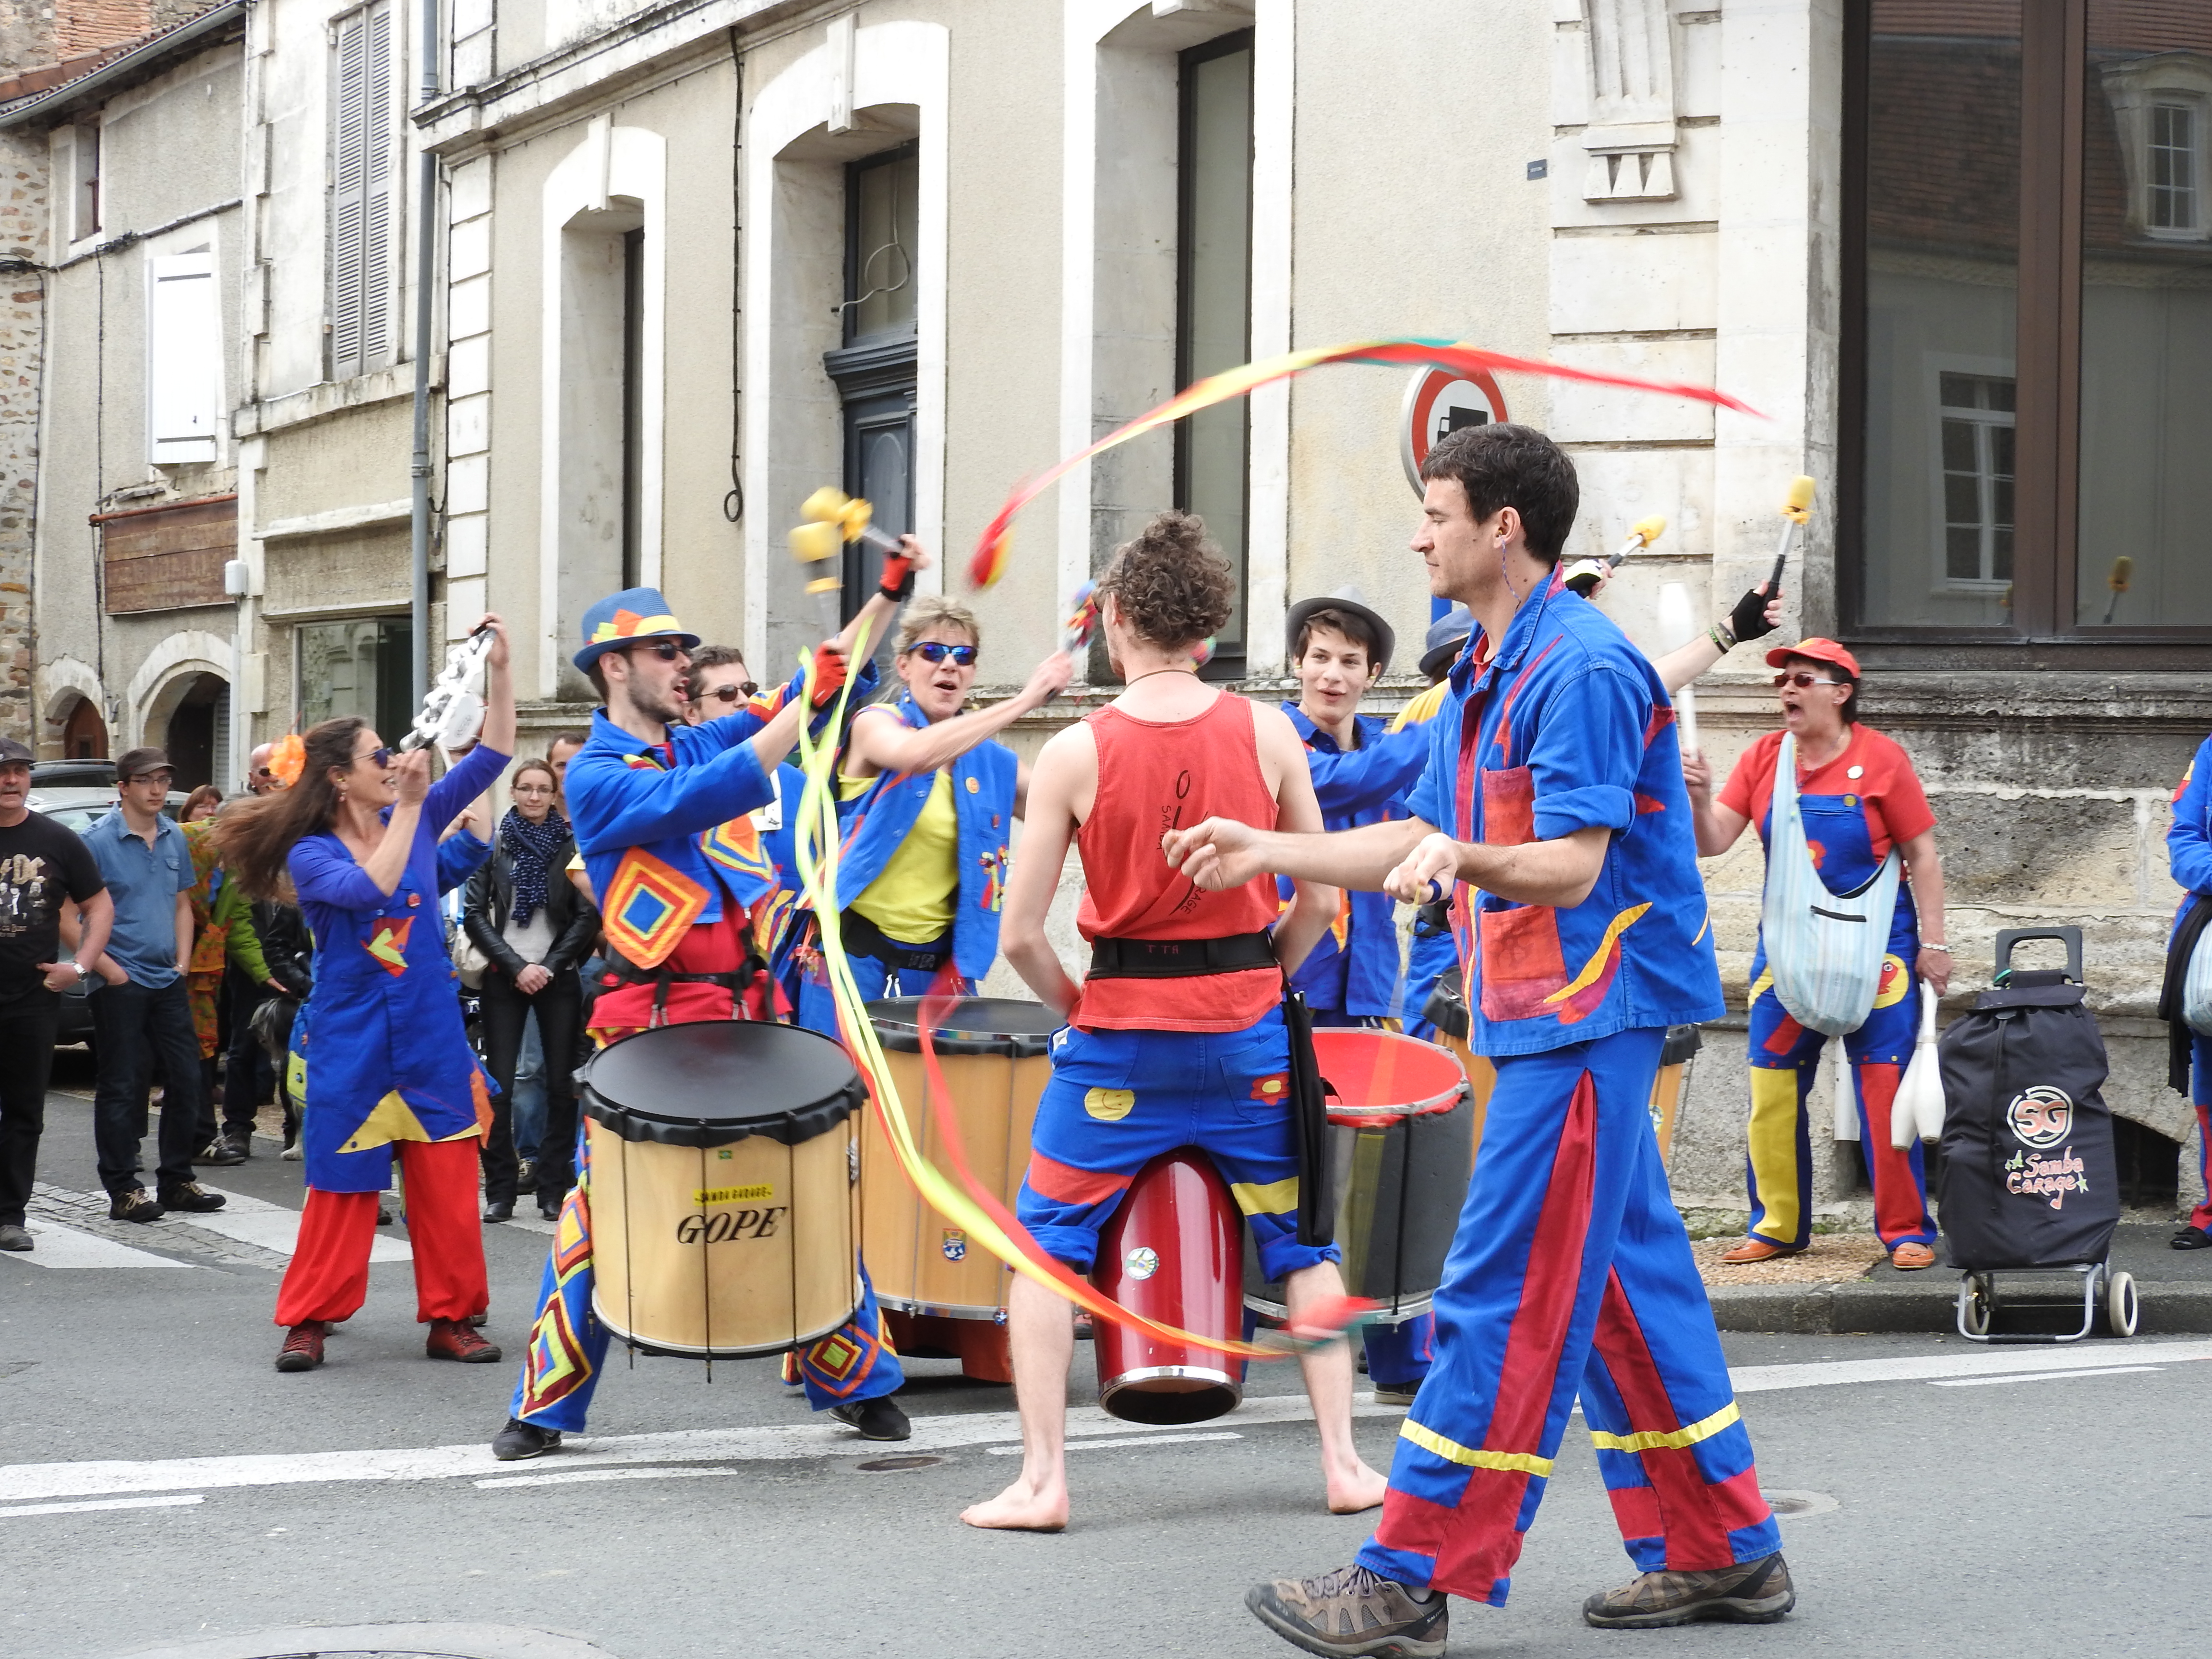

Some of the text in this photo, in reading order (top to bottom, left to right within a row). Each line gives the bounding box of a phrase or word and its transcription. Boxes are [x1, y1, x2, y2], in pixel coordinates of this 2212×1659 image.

[1180, 886, 1206, 915] RAGE
[2014, 1099, 2068, 1137] SG
[2022, 1146, 2084, 1178] Samba
[677, 1206, 788, 1244] GOPE
